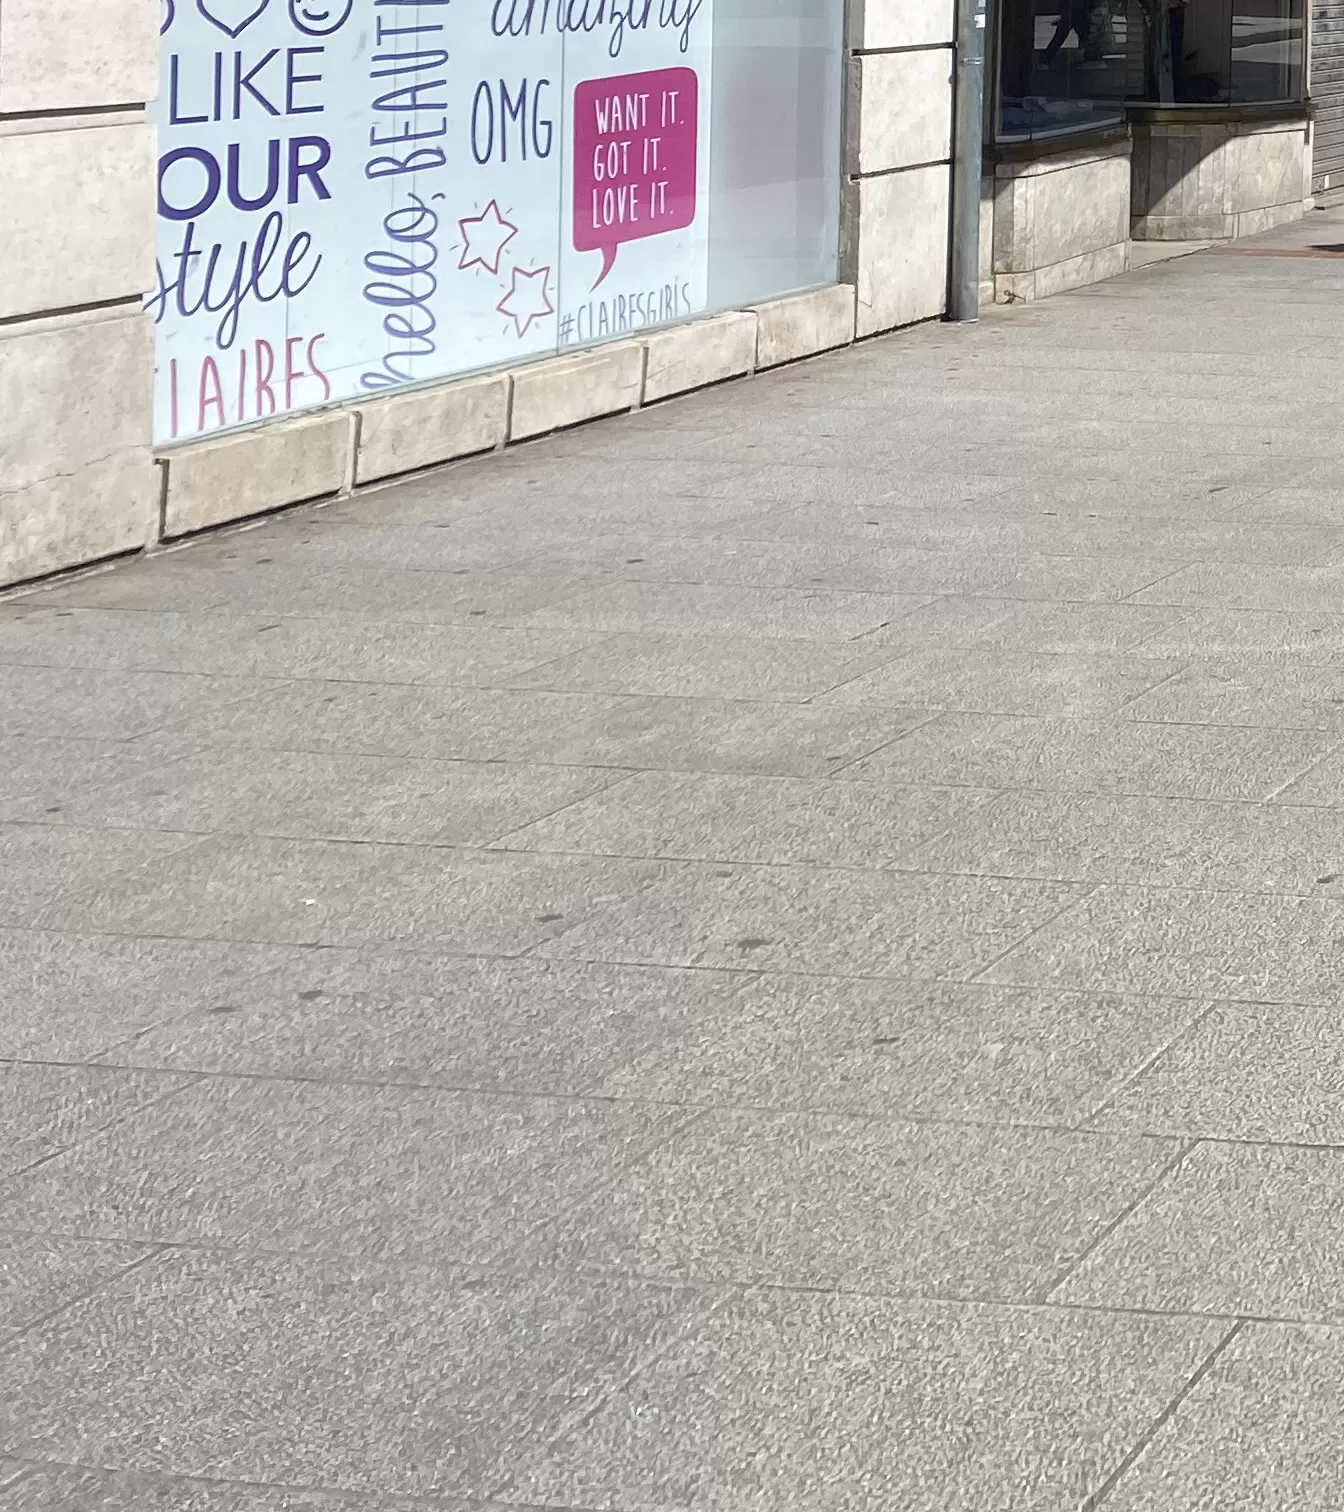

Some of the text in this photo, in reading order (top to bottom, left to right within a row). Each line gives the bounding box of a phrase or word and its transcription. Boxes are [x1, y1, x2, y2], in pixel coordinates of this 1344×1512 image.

[168, 46, 326, 126] LIKE
[471, 78, 553, 166] OMG
[595, 90, 685, 134] WANT IT.
[593, 138, 667, 181] GOT IT.
[592, 181, 674, 229] LOVE IT.
